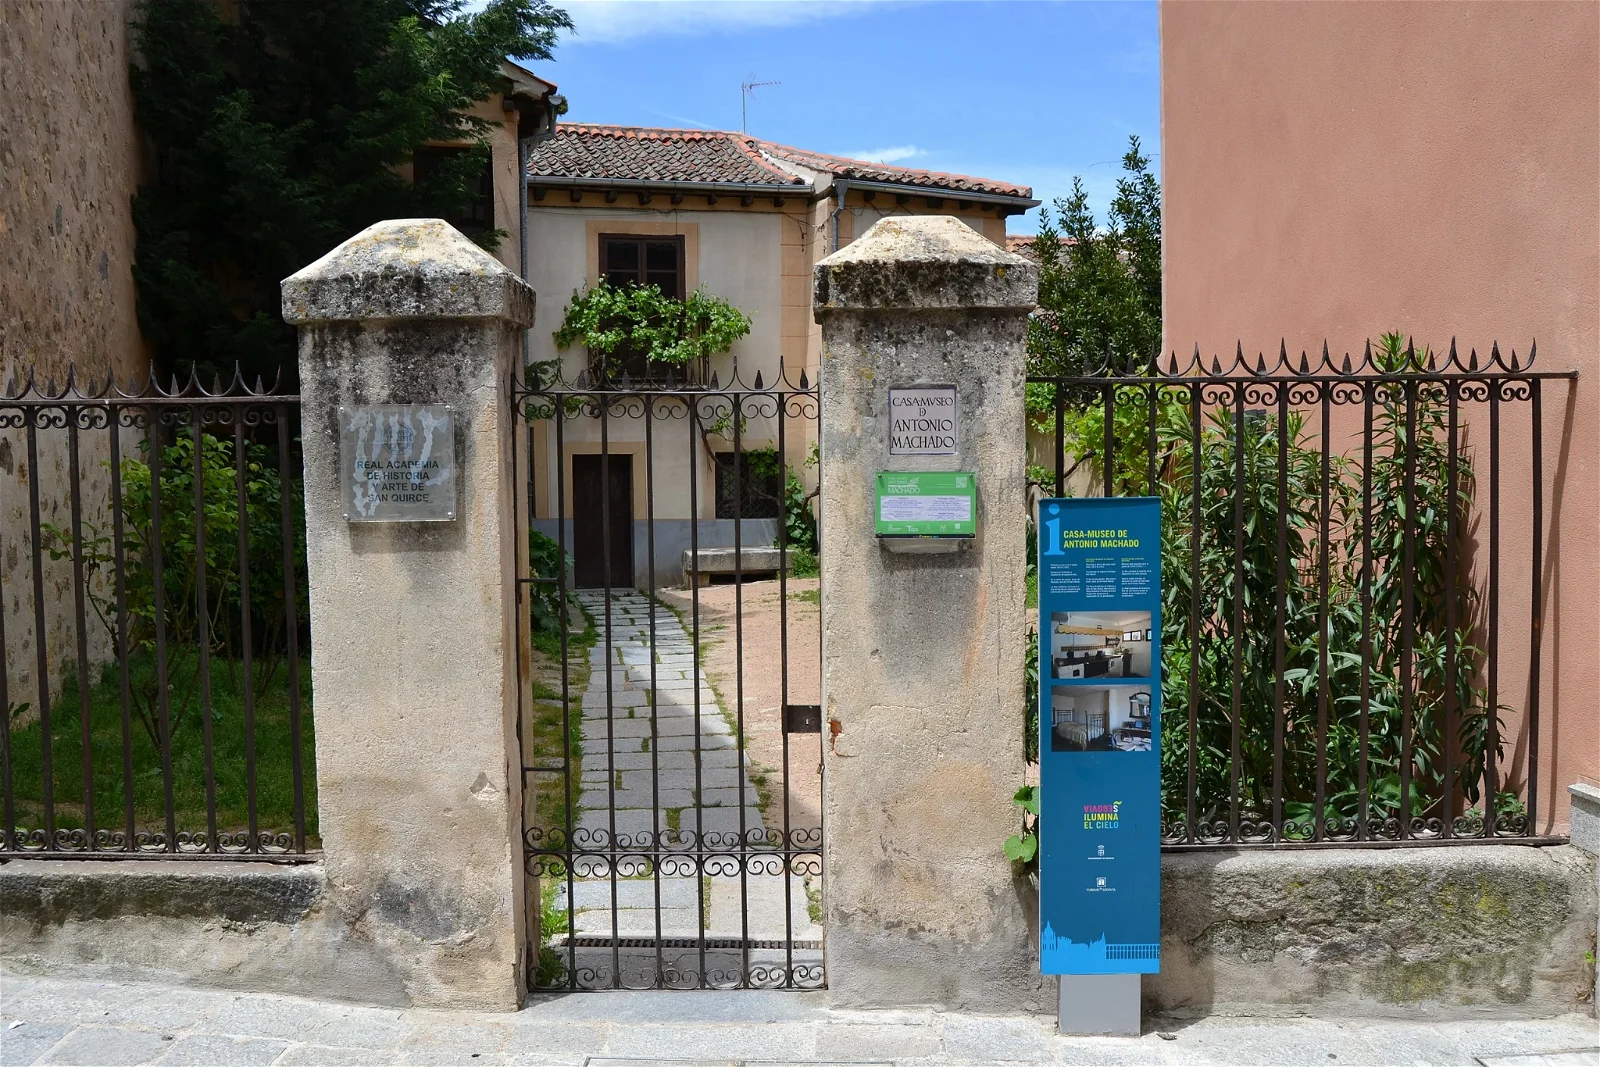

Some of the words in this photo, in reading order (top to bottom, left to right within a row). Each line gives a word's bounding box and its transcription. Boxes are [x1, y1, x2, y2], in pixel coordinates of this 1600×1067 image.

[893, 419, 953, 431] ANTONIO
[891, 435, 955, 448] MACHADO
[357, 461, 383, 469] REAL
[386, 461, 439, 469] ACADEMIA
[367, 472, 380, 480] DE
[383, 472, 430, 480] HISTORIA
[372, 483, 379, 491] Y
[381, 483, 408, 491] ARTE
[411, 483, 424, 491] DE
[367, 494, 388, 502] SAN
[391, 494, 429, 502] QUIRCE
[1063, 530, 1115, 538] CASA-MUSEO
[1117, 530, 1128, 538] DE
[1063, 540, 1098, 548] ANTONIO
[1100, 539, 1139, 548] MACHADO
[1084, 812, 1118, 820] ILUMINA
